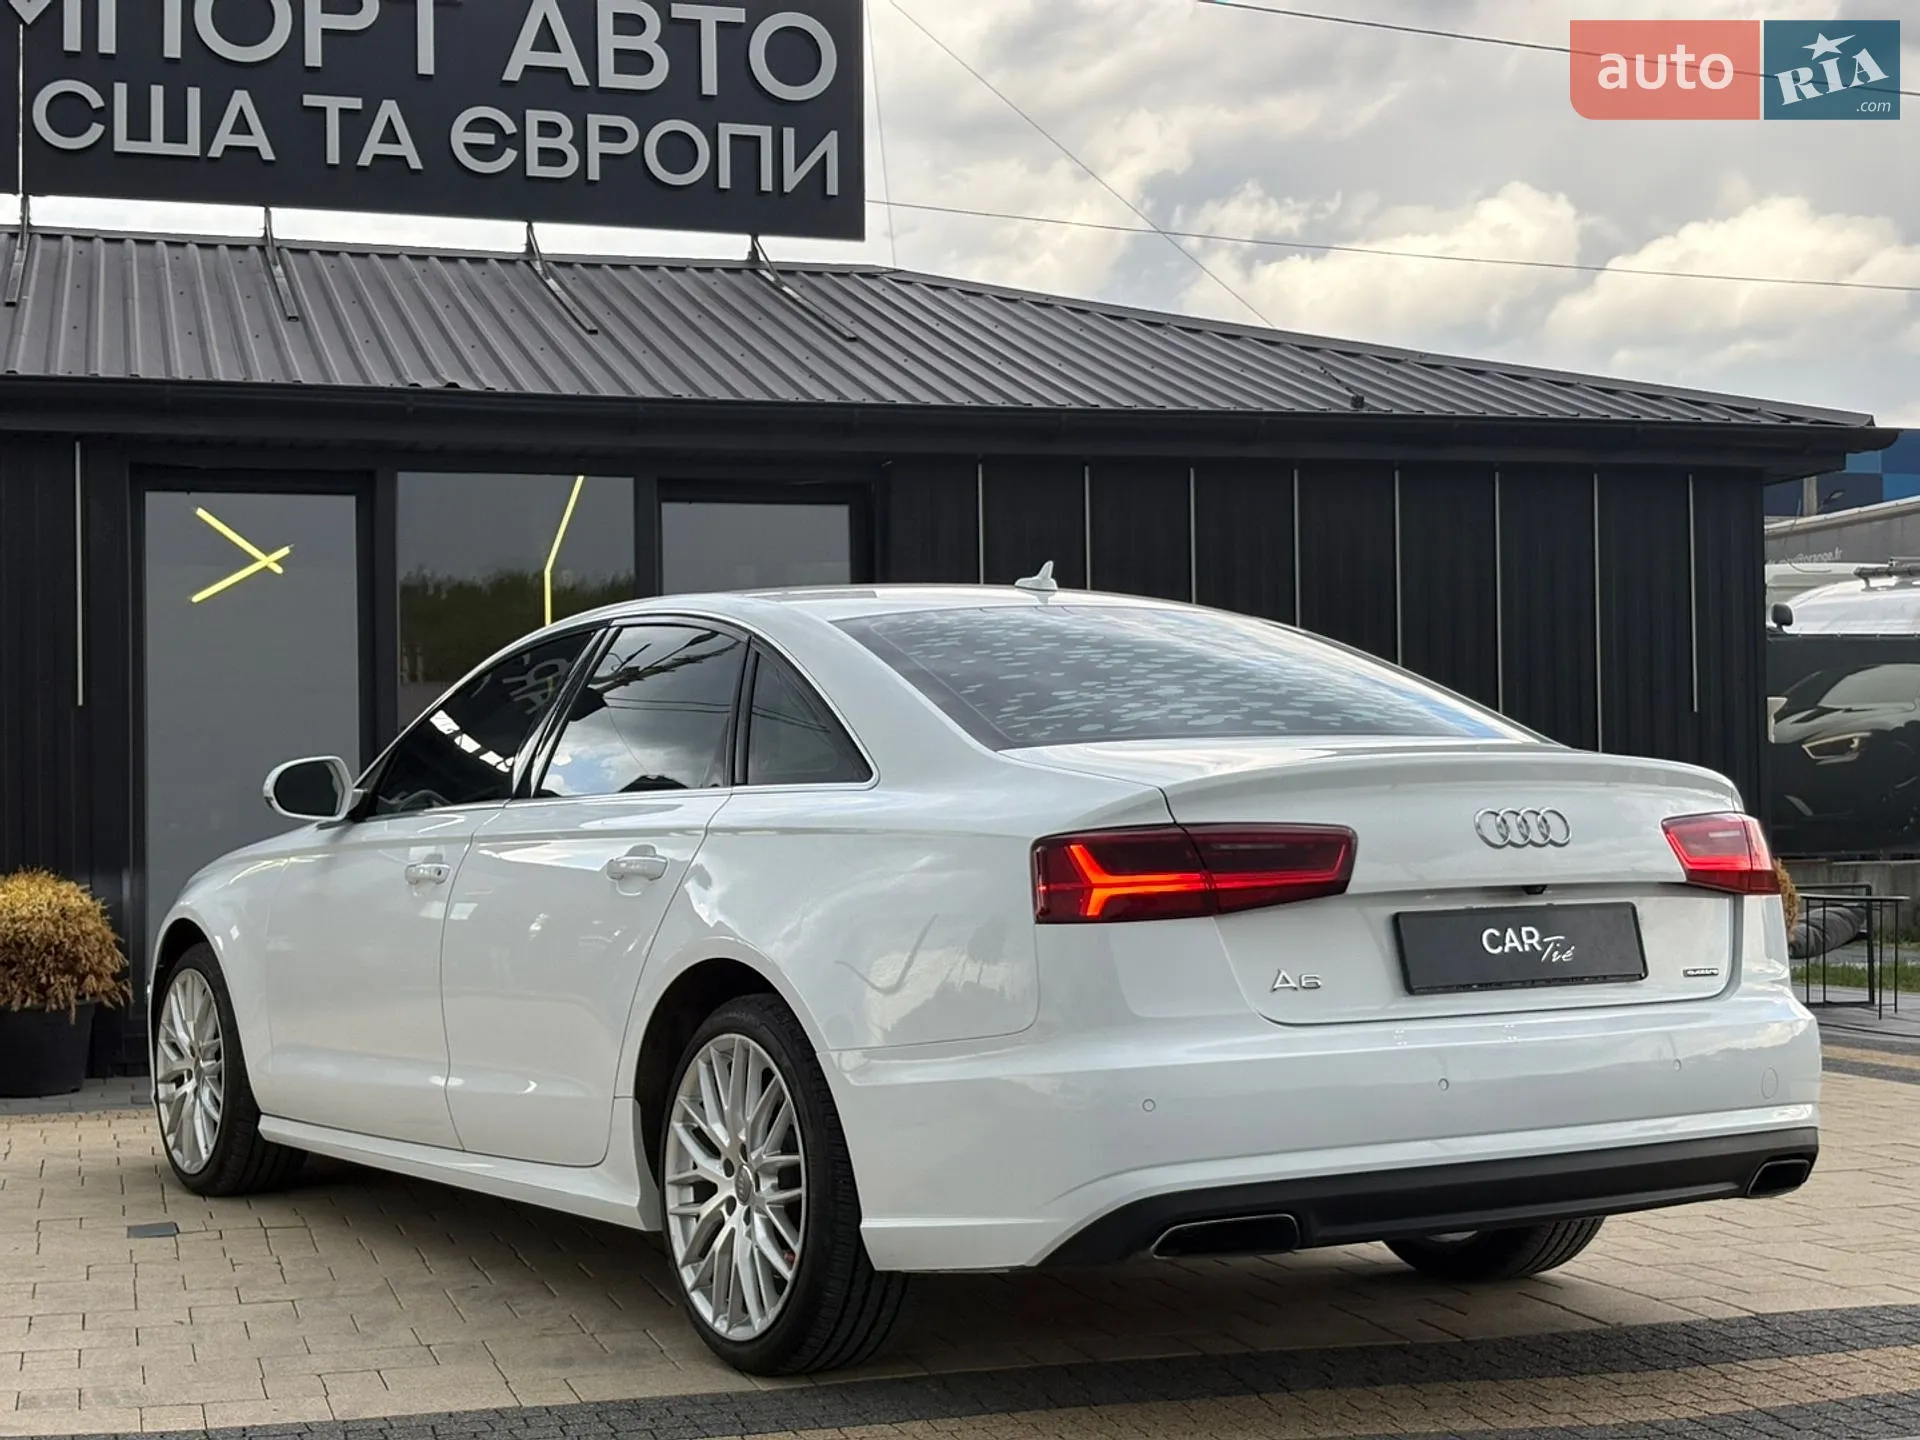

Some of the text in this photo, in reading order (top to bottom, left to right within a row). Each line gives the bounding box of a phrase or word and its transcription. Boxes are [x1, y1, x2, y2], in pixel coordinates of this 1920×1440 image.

[501, 0, 838, 101] АВТО
[32, 79, 839, 196] США ТА ЄВРОПИ
[1482, 926, 1542, 954] CAR
[1271, 969, 1322, 991] A6
